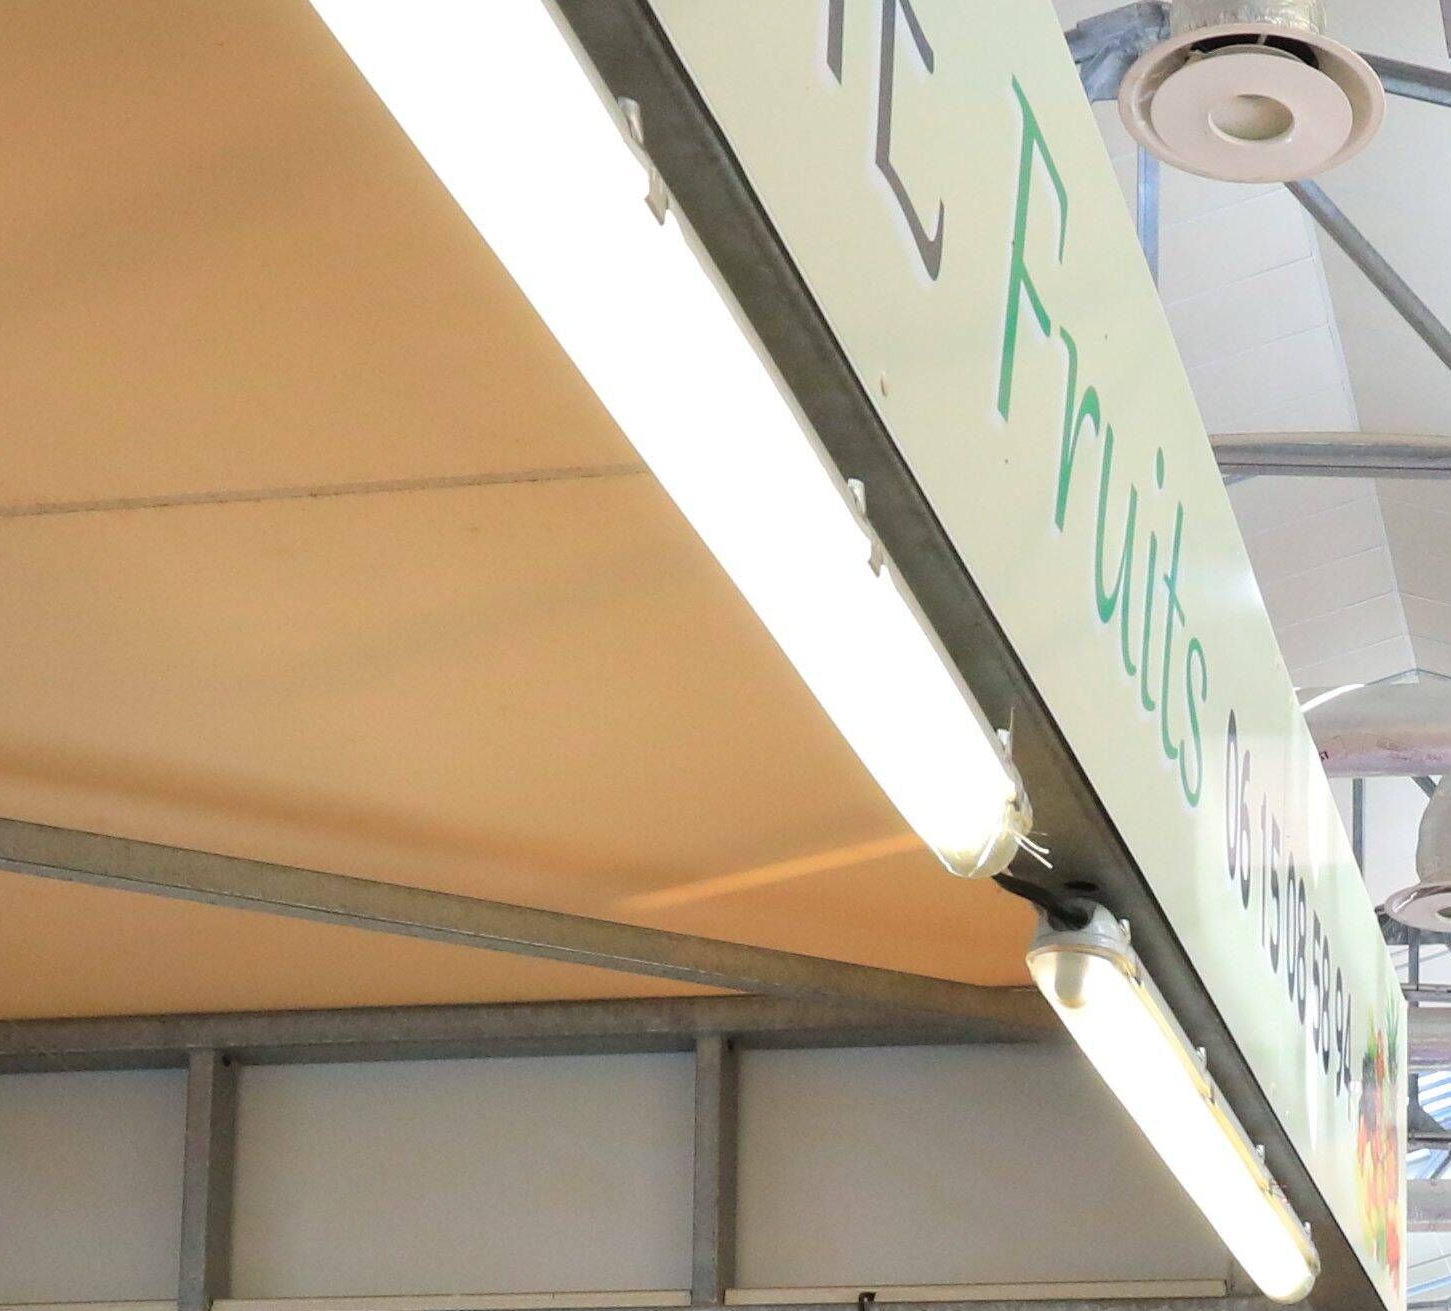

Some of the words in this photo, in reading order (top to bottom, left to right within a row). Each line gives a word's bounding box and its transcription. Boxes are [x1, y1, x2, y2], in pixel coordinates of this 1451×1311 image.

[997, 75, 1210, 808] Fruits
[1226, 709, 1251, 910] 06
[1260, 792, 1281, 974] 15
[1286, 852, 1306, 1025] 08
[1313, 910, 1330, 1075] 58
